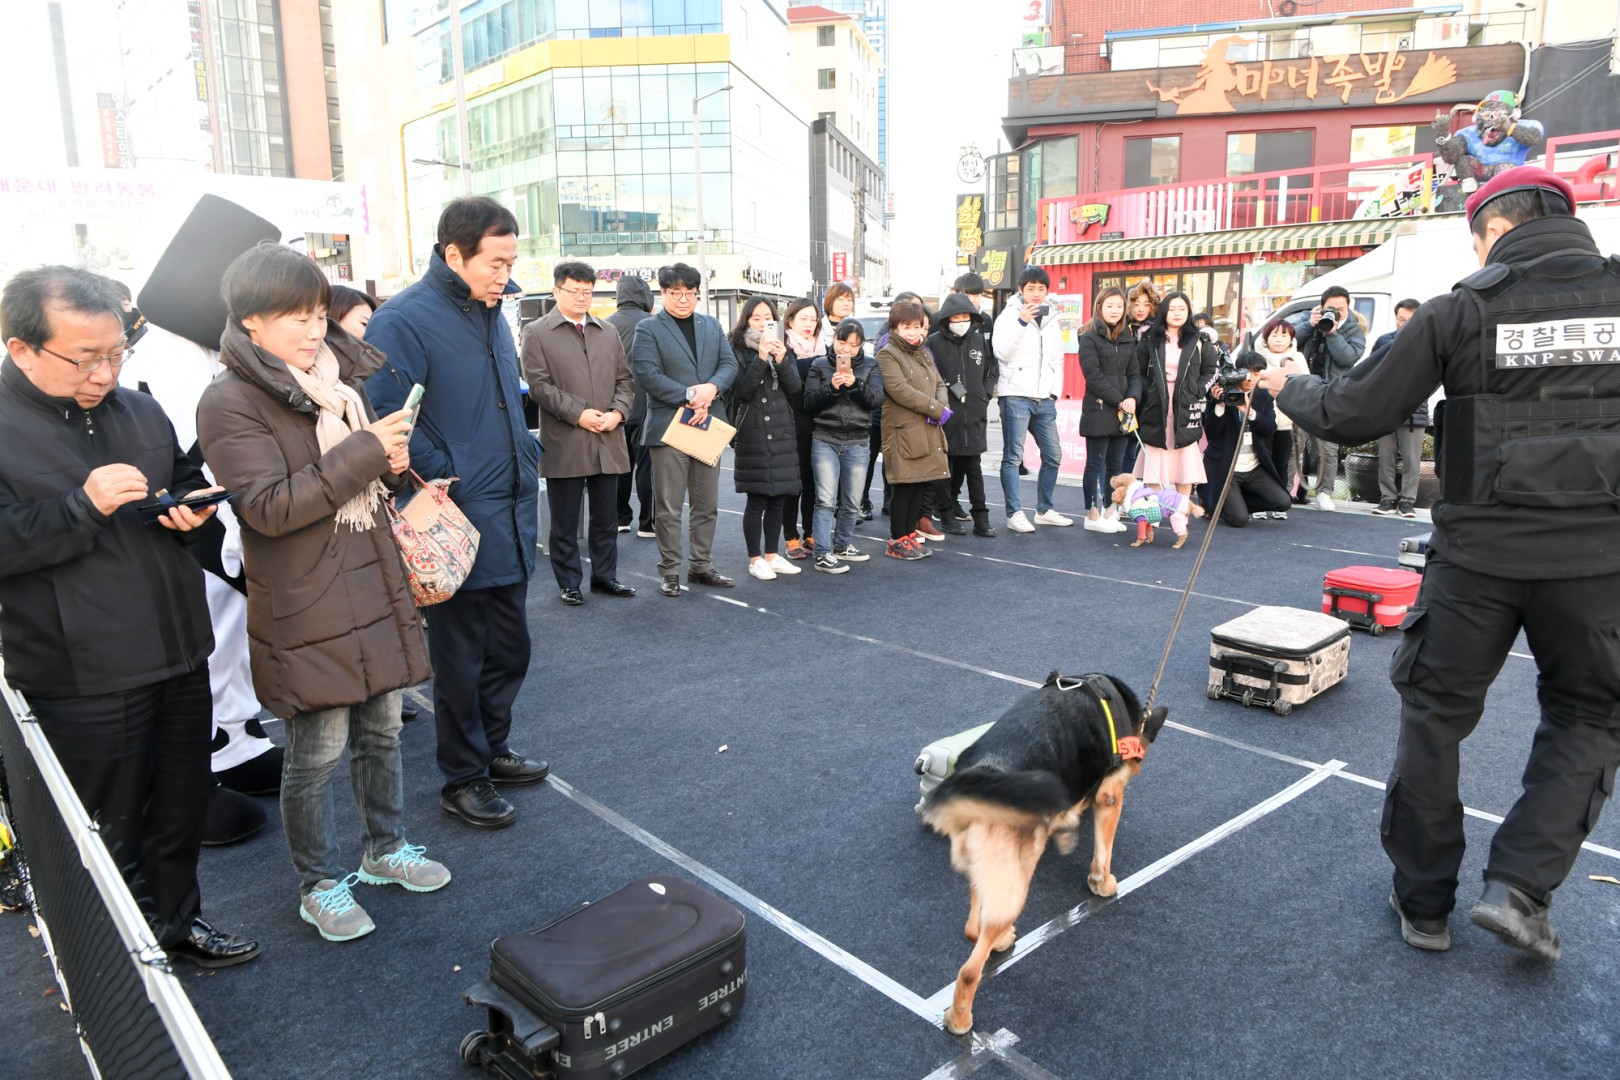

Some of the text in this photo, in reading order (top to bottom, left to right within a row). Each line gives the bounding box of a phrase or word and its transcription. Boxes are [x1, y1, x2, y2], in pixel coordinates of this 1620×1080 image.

[1235, 50, 1406, 104] 마녀족발
[70, 179, 156, 198] 반려동물
[1503, 322, 1616, 351] 경찰특공
[604, 1014, 675, 1061] ENTREE
